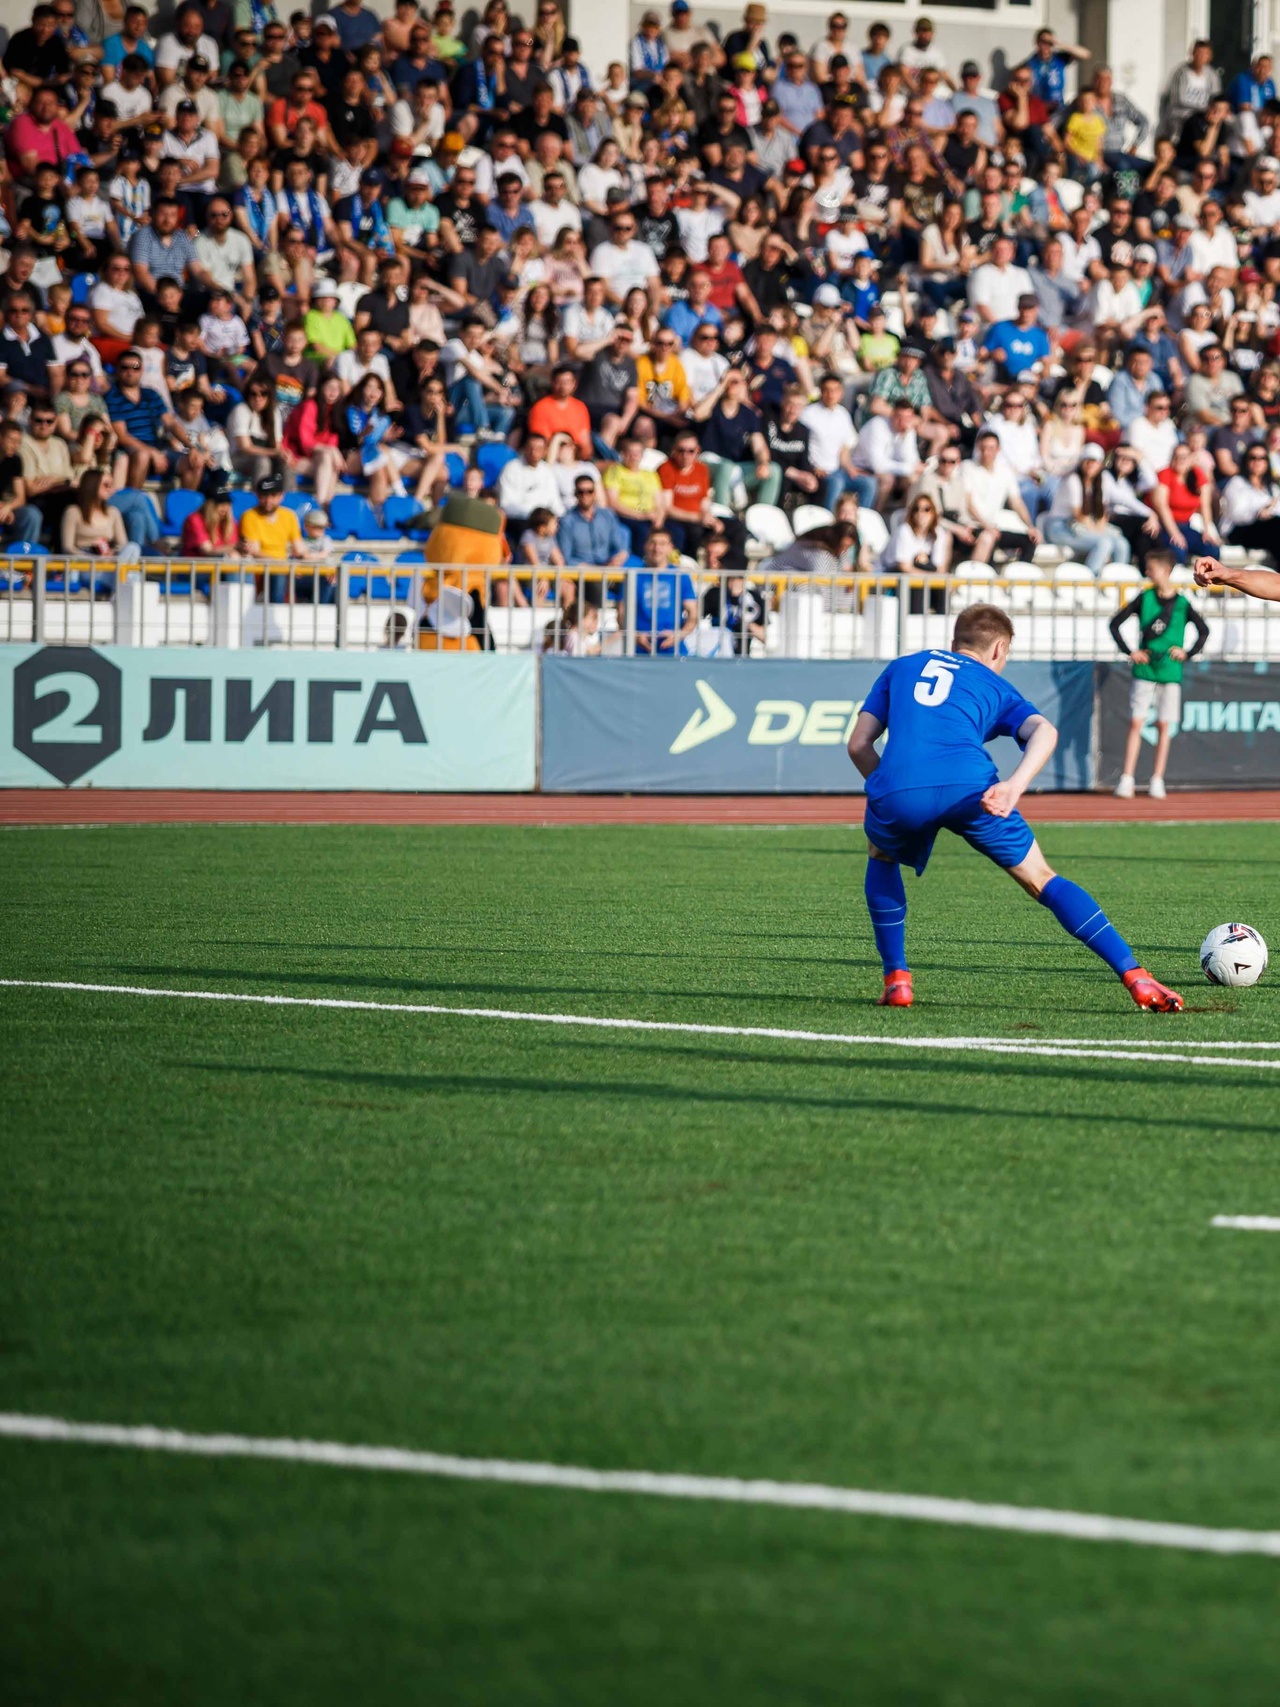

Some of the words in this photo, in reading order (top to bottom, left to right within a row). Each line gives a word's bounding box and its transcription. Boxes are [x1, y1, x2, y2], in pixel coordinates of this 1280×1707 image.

[32, 671, 103, 744] 2
[143, 677, 428, 744] ЛИГА
[914, 659, 960, 707] 5
[748, 700, 889, 745] DE
